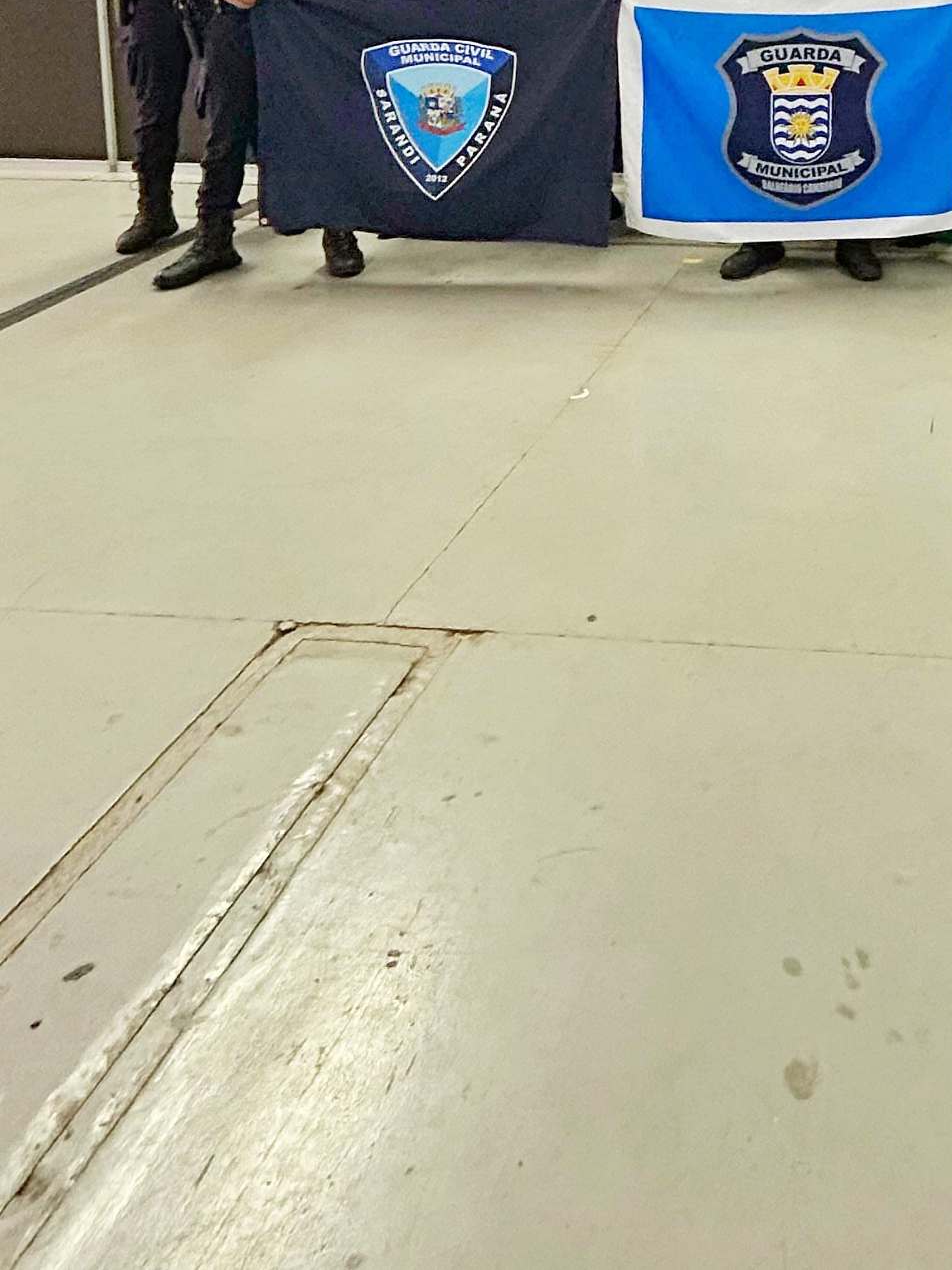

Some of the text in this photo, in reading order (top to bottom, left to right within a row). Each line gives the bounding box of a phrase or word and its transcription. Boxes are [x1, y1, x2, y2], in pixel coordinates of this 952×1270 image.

[388, 42, 495, 60] GUARDA CIVIL
[400, 52, 481, 67] MUNICIPAL
[760, 47, 842, 63] GUARDA
[375, 88, 421, 165] SARANDI
[755, 162, 848, 179] MUNICIPAL
